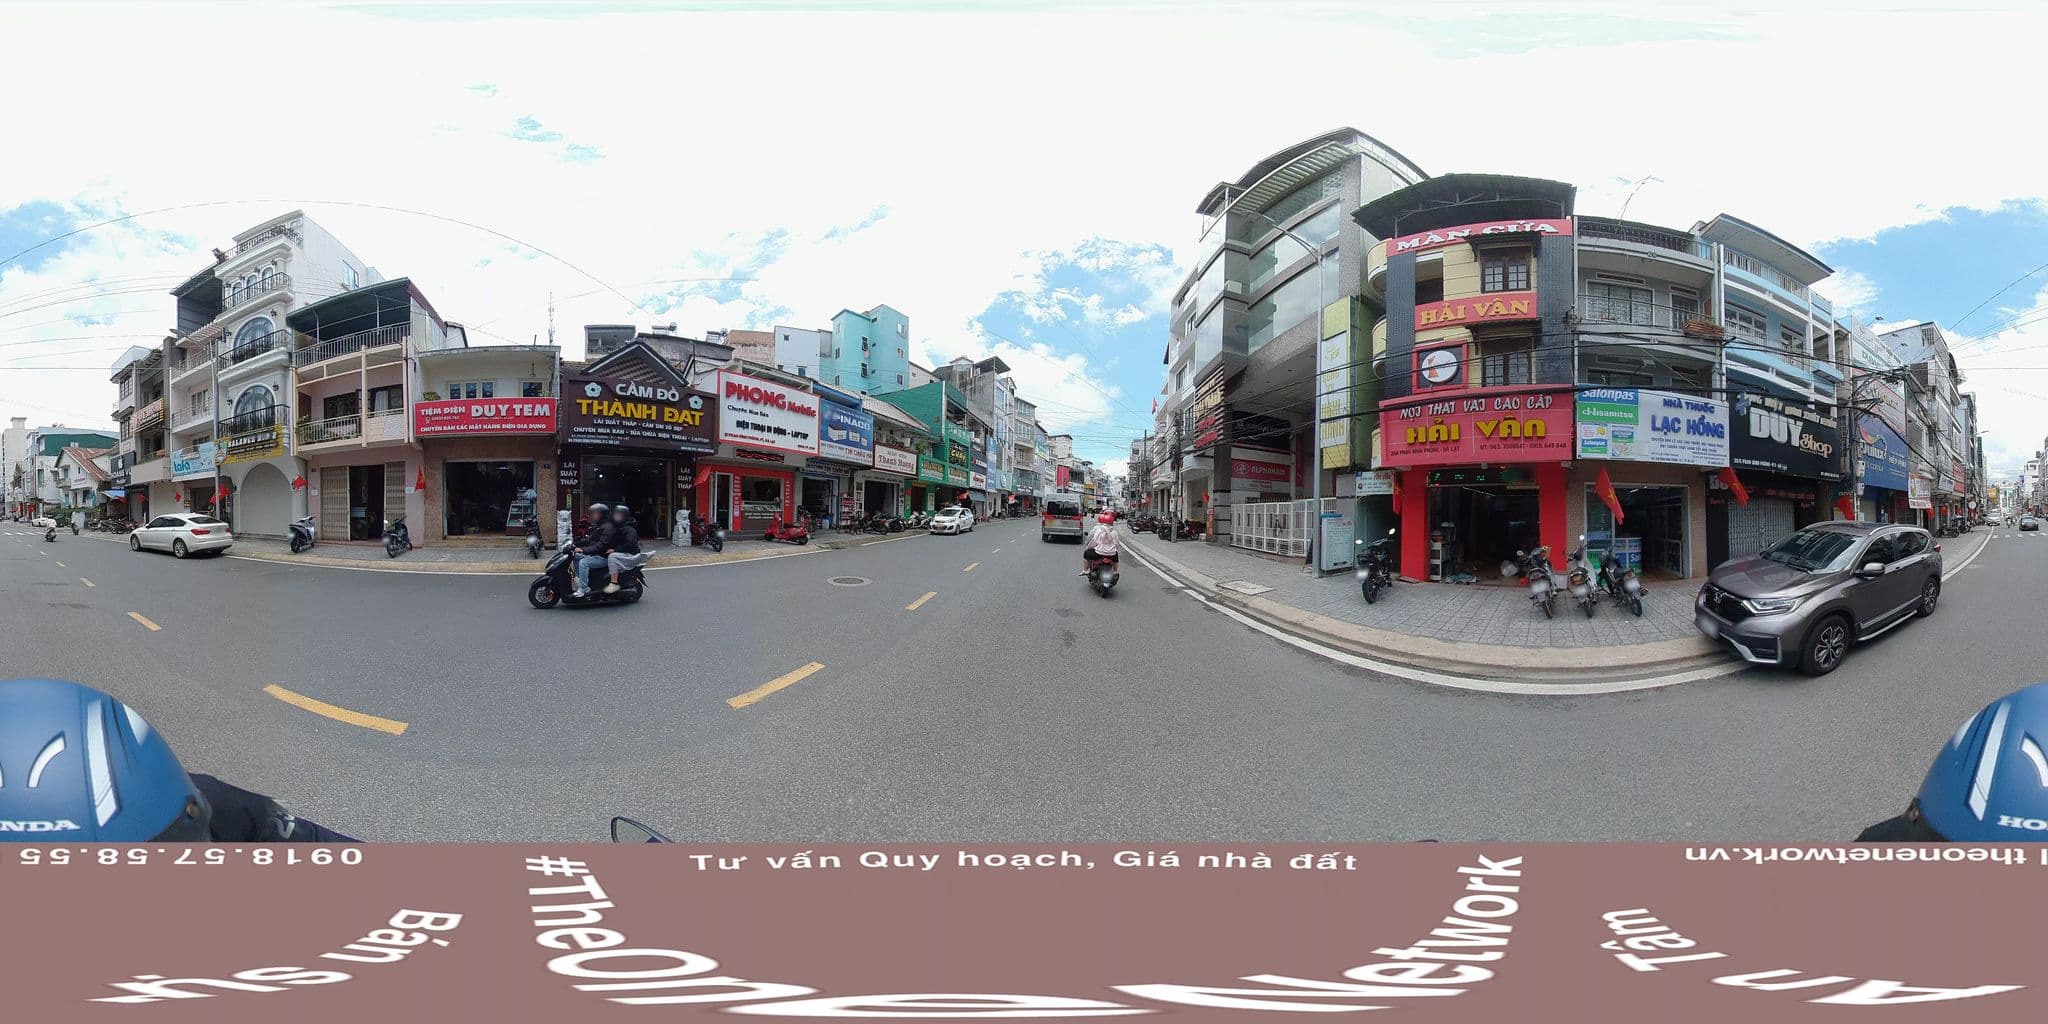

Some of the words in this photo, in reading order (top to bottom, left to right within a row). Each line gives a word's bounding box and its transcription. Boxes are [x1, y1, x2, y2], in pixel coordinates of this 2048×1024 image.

[1397, 228, 1472, 251] MÀN
[1419, 302, 1467, 326] HẢI
[1472, 298, 1530, 317] VÂN
[615, 381, 653, 398] CẦM
[656, 386, 680, 401] ĐỒ
[725, 381, 787, 410] PHONG
[787, 401, 817, 418] Mobile
[1582, 388, 1635, 401] Salonpas
[420, 407, 442, 416] TIỆM
[443, 406, 466, 415] ĐIỆN
[471, 404, 510, 418] DUY
[512, 404, 551, 417] TEM
[576, 398, 657, 420] THÀNH
[663, 407, 704, 427] ĐẠT
[1493, 396, 1521, 410] CAO
[1663, 398, 1682, 409] NHÀ
[1685, 401, 1715, 414] THUỐC
[1407, 417, 1460, 444] HẢI
[1476, 414, 1546, 439] VÂN
[1651, 415, 1682, 436] LẠC
[1687, 415, 1725, 439] HỒNG
[1749, 407, 1803, 447] DUY
[1800, 433, 1833, 459] Shop
[560, 469, 578, 477] SUẤT
[560, 478, 578, 486] THẤP
